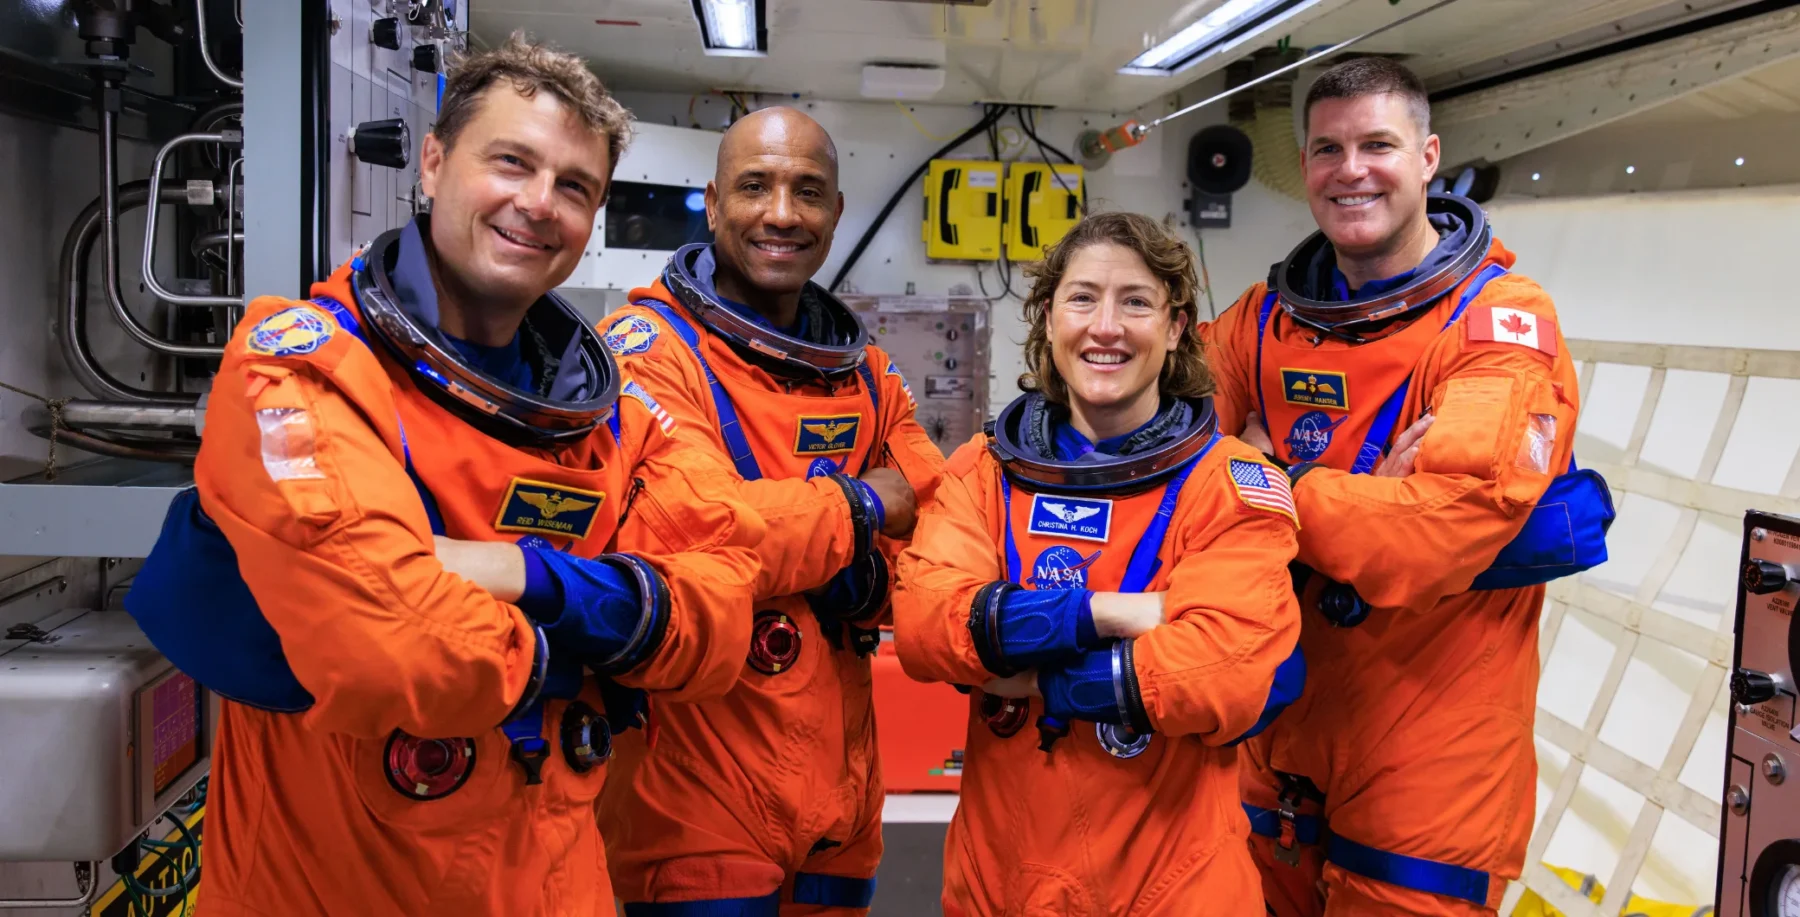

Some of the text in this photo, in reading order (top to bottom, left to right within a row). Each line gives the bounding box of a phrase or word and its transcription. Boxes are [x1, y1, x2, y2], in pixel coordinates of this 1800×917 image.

[1314, 397, 1337, 405] HANSEN
[1293, 428, 1328, 443] NASA
[516, 516, 573, 531] REID WISEMAN
[1038, 520, 1068, 530] CHRISTINA
[1080, 525, 1098, 534] KOCH
[1037, 565, 1084, 583] NASA
[1766, 603, 1779, 612] VENT
[1771, 714, 1790, 729] ISOLATION
[127, 833, 203, 917] AUTIO
